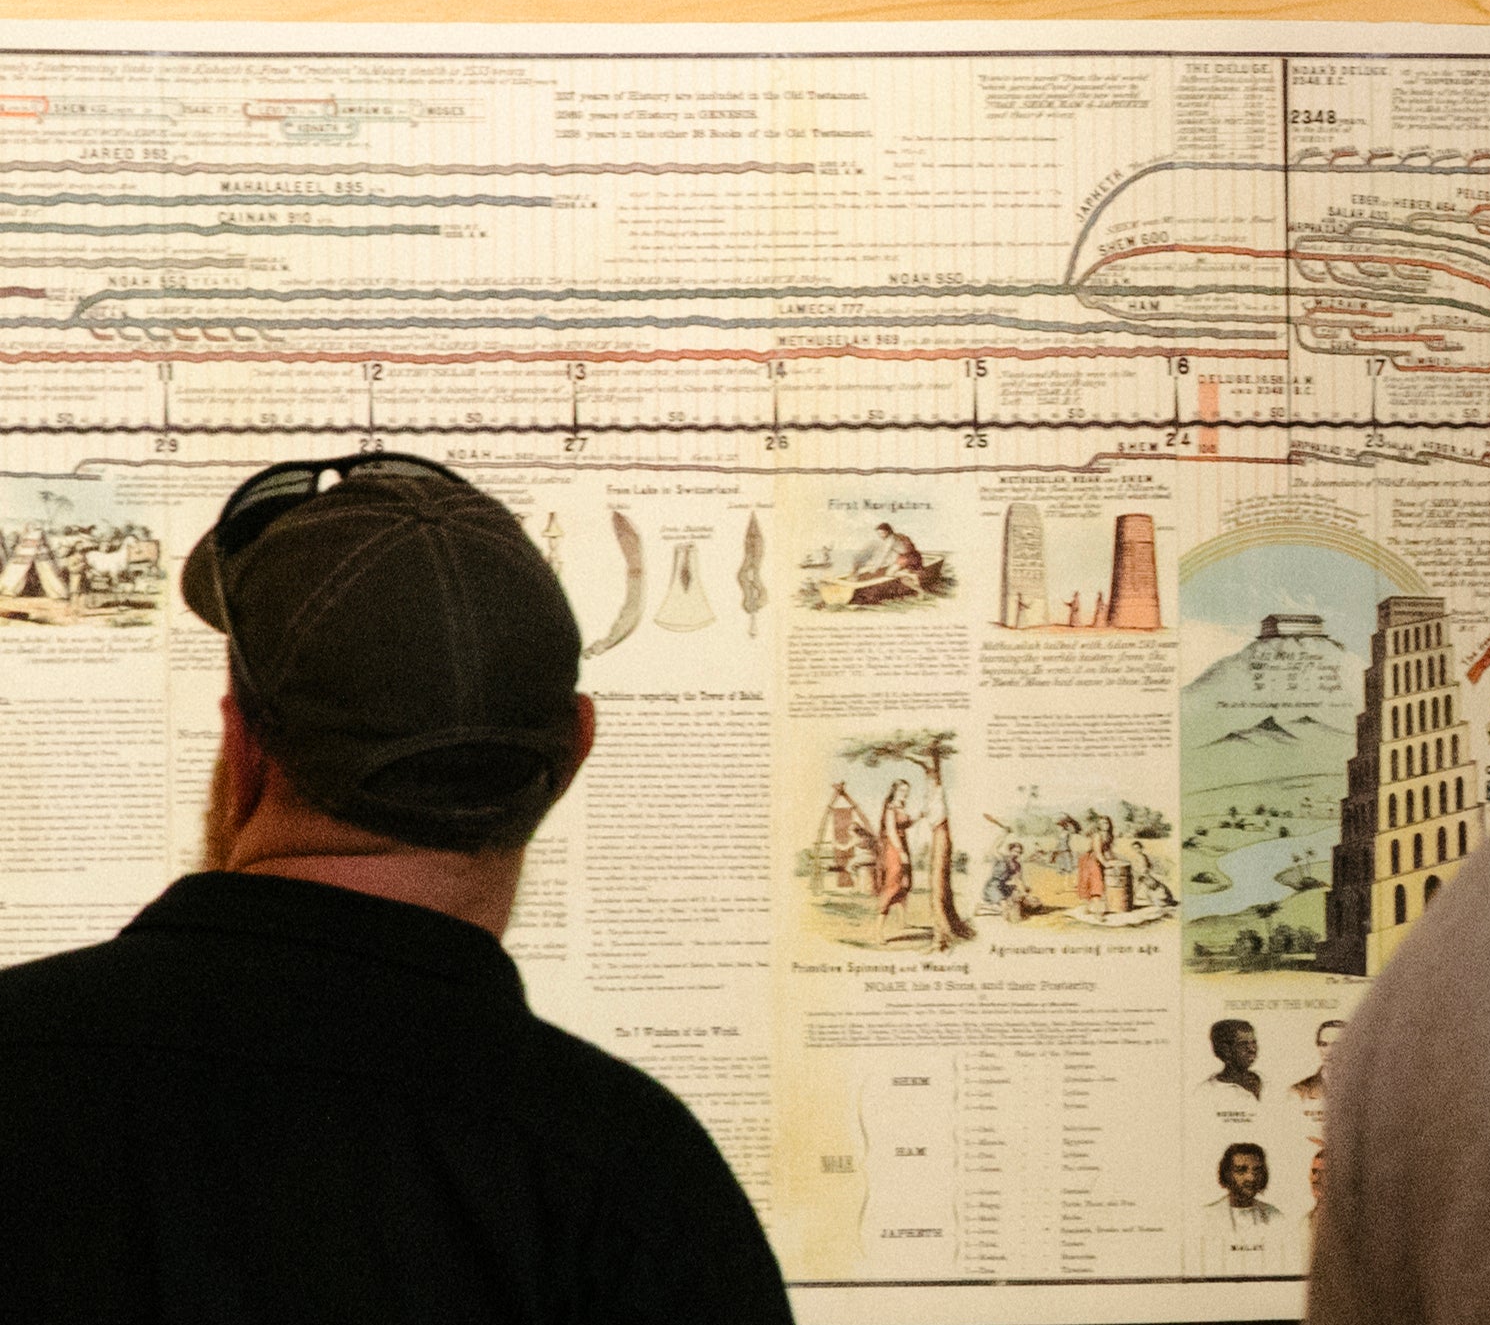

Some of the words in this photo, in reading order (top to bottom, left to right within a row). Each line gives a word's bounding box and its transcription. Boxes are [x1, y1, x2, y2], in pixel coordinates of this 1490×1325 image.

[1185, 64, 1211, 74] THE
[1291, 110, 1337, 124] 2348
[79, 147, 134, 160] JARED
[220, 181, 324, 193] MAHALALEEL
[108, 276, 150, 287] NOAH
[889, 273, 934, 284] NOAH
[1129, 301, 1159, 312] HAM
[157, 363, 172, 381] 11
[362, 363, 382, 381] 12
[566, 363, 587, 380] 13
[766, 362, 787, 379] 14
[965, 360, 987, 377] 15
[1167, 358, 1190, 375] 16
[1365, 359, 1386, 377] 17
[155, 439, 178, 453] 29
[564, 438, 587, 452] 27
[766, 436, 789, 450] 26
[964, 434, 988, 449] 25
[1166, 433, 1190, 448] 24
[1365, 433, 1385, 448] 23
[846, 961, 896, 974] Spinning
